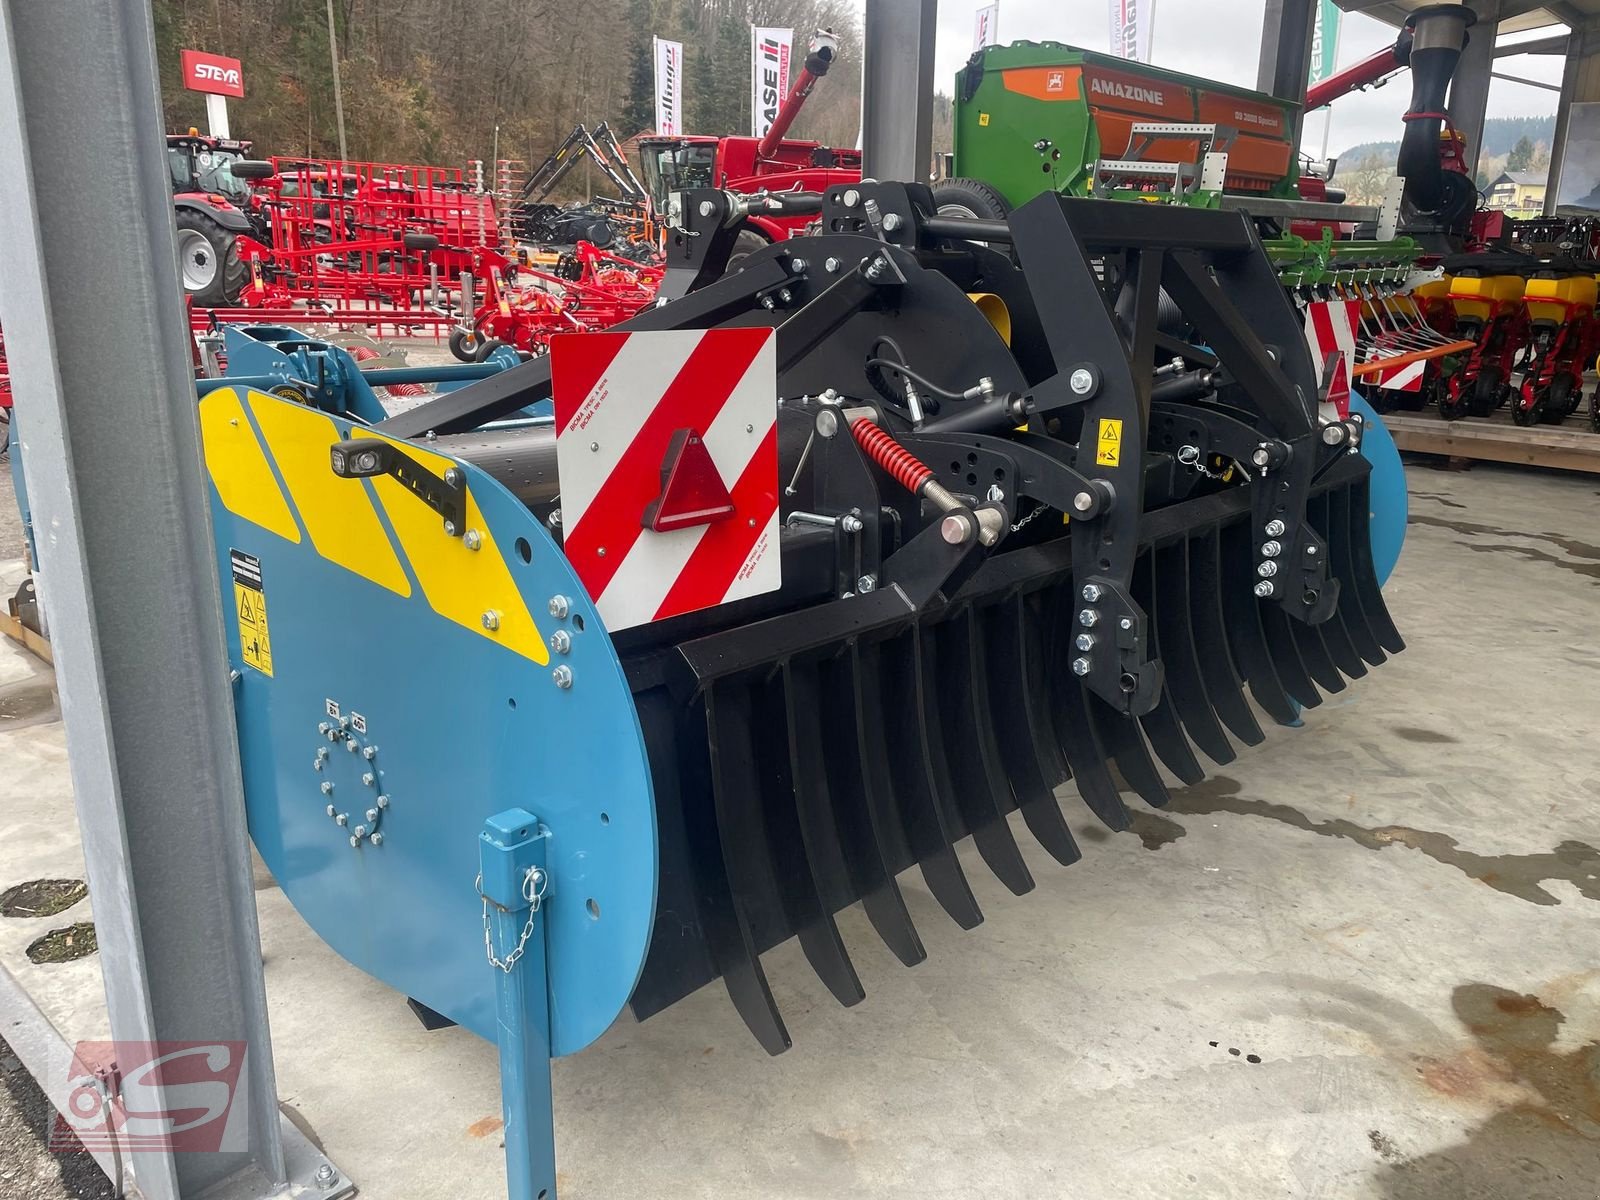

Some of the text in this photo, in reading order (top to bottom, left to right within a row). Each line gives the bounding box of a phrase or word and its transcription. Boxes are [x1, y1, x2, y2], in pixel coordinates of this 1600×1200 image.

[195, 63, 239, 84] STEYR
[1091, 78, 1164, 106] AMAZONE
[570, 412, 584, 431] BICMA
[580, 410, 594, 429] BICMA
